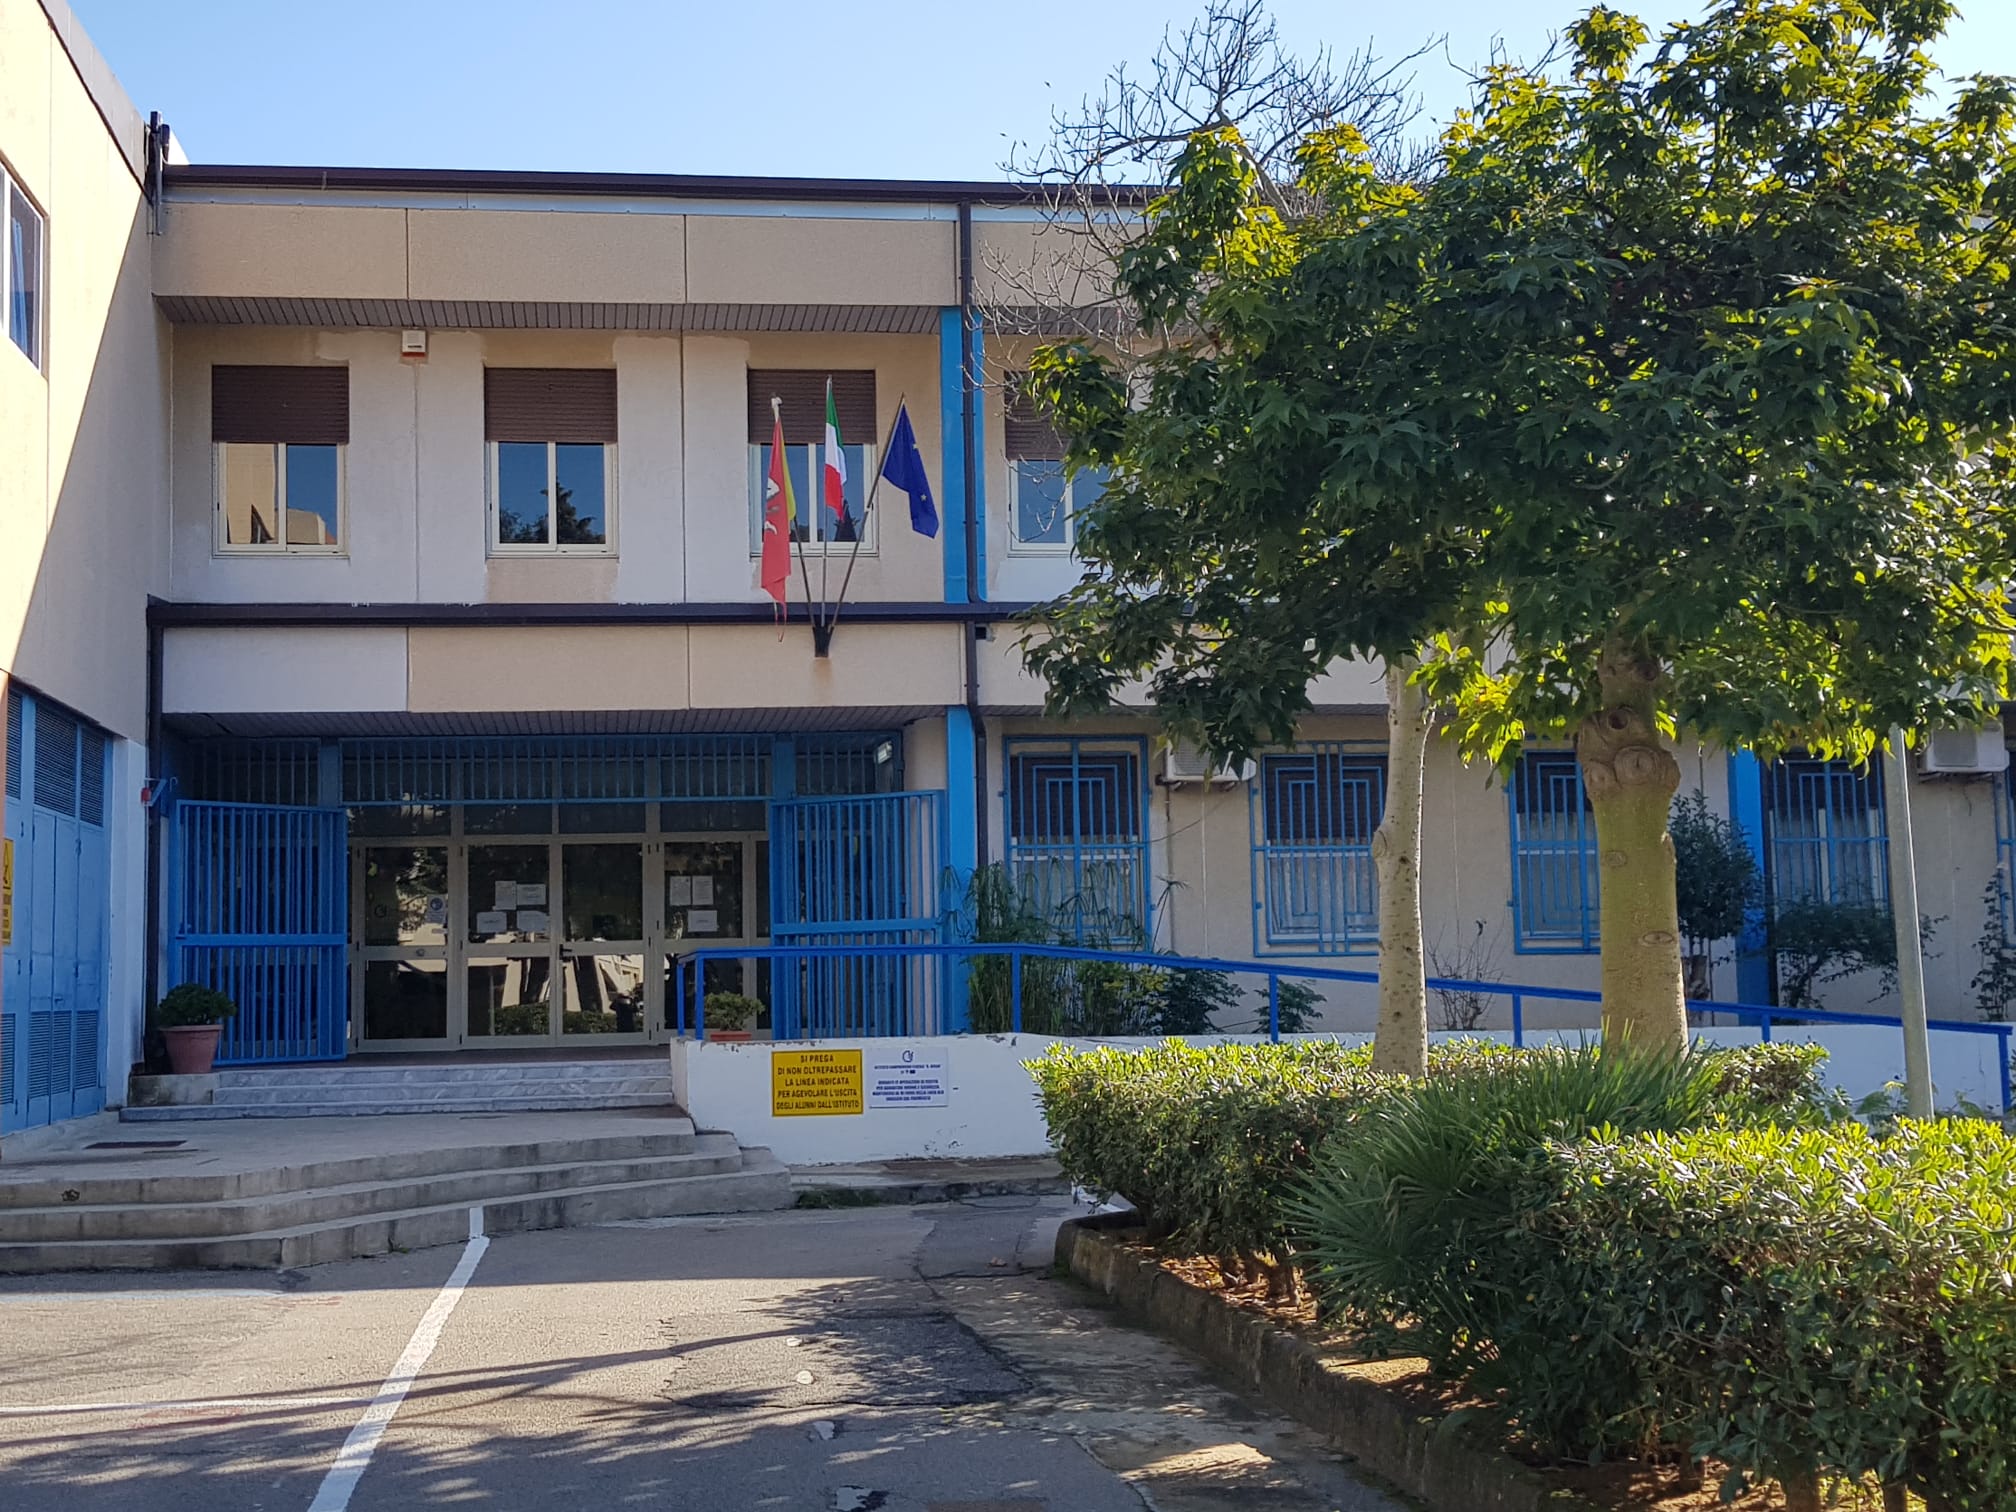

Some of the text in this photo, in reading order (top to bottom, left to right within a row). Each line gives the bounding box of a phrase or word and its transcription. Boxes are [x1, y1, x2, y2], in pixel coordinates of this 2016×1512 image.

[801, 1054, 834, 1063] SI PREGA
[778, 1065, 856, 1075] DI NON OLTREPASSARE
[785, 1077, 849, 1086] LA LINEA INDICATA
[778, 1088, 857, 1098] PER AGEVOLARE L'USCITA
